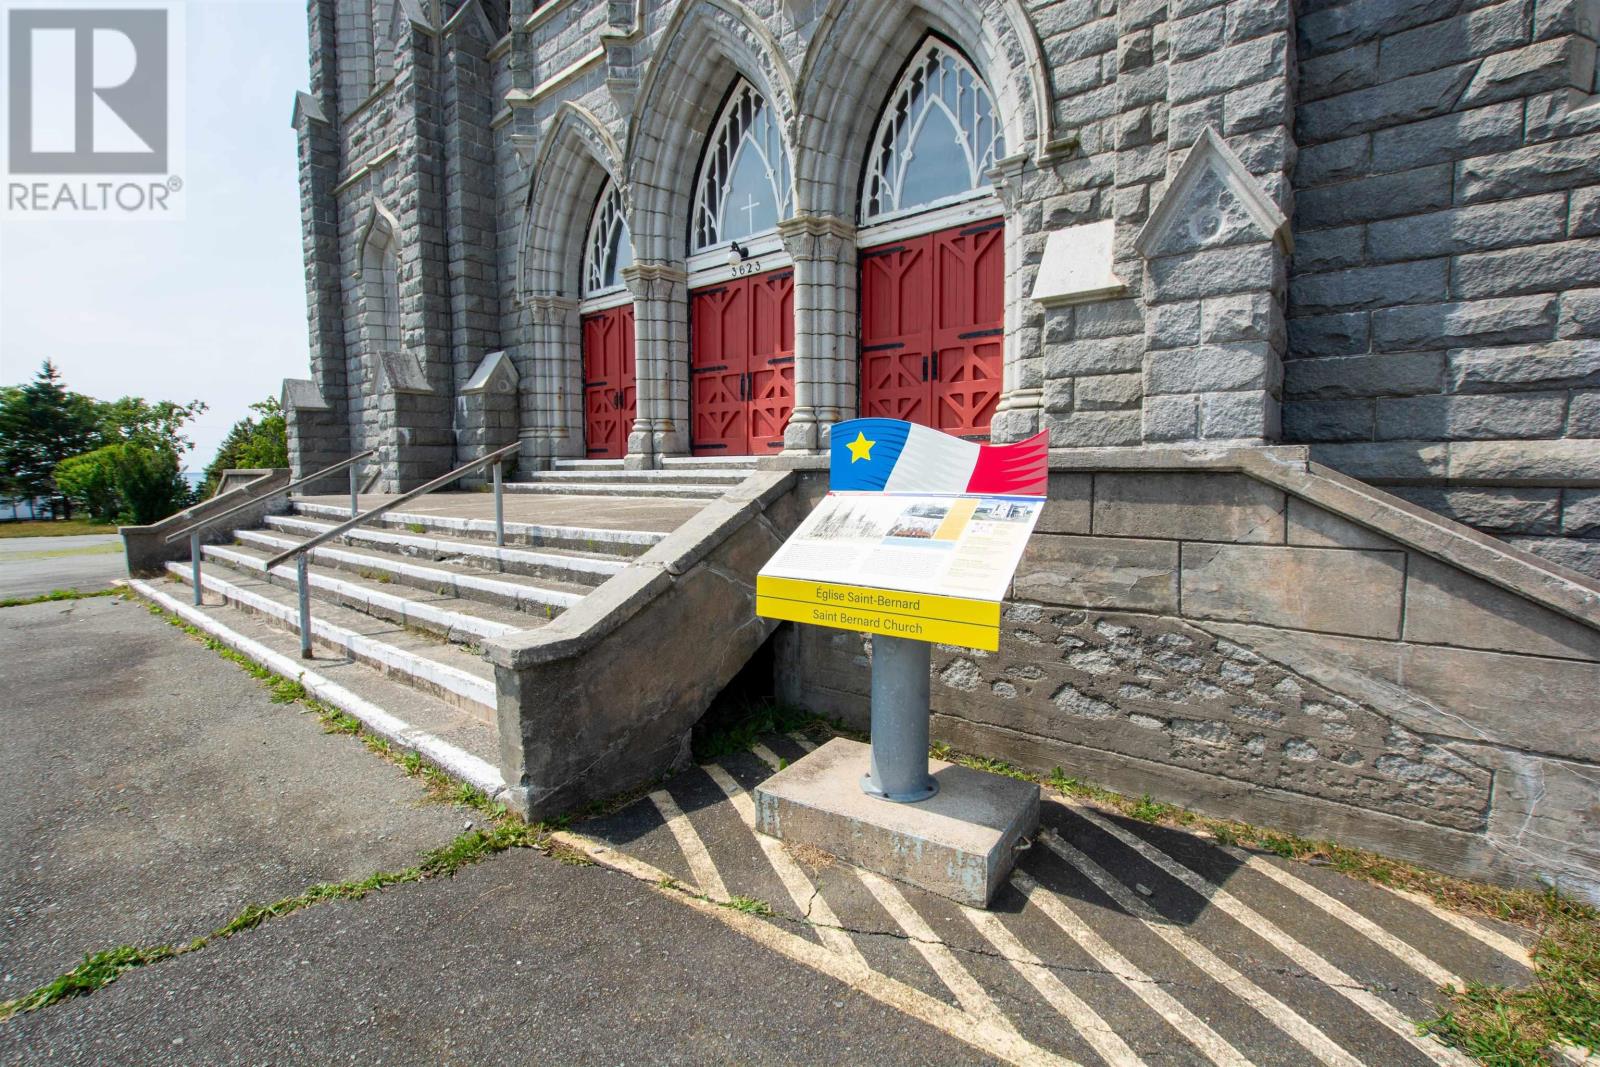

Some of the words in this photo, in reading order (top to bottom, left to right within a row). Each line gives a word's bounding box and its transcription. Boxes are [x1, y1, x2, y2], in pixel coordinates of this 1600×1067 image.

[731, 261, 761, 277] 3623
[816, 587, 844, 601] Église
[847, 592, 920, 611] Saint-Bernard
[813, 609, 838, 622] Saint
[840, 613, 880, 628] Bernard
[884, 619, 922, 634] Church
